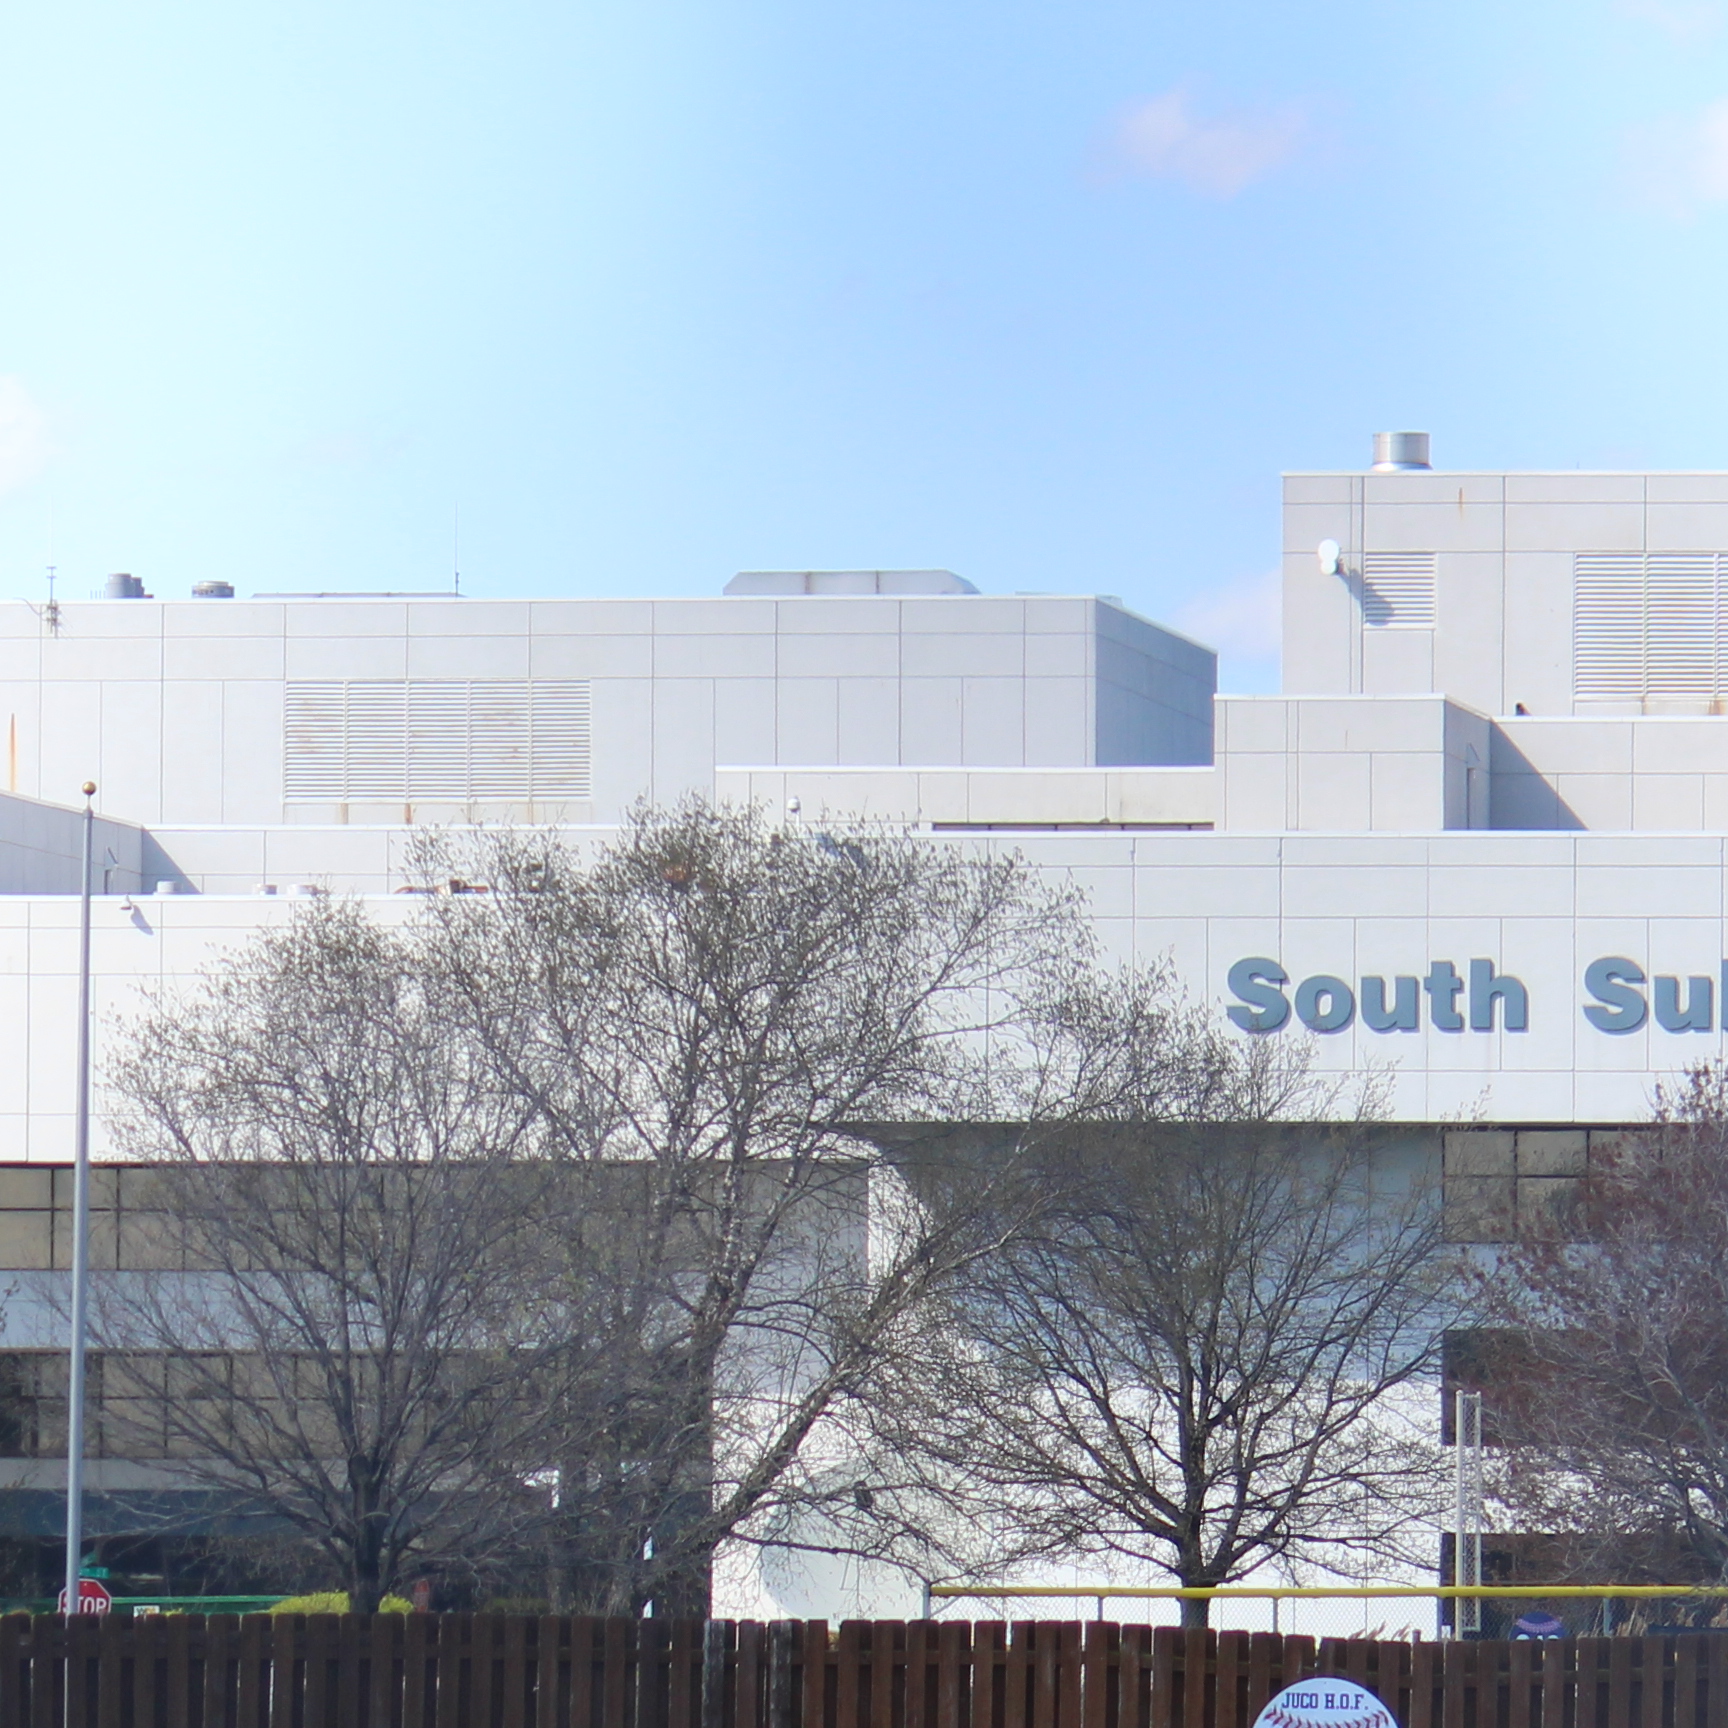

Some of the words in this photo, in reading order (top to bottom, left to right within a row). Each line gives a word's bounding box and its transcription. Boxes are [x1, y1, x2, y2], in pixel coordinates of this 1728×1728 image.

[1226, 956, 1529, 1034] South
[1282, 1693, 1319, 1709] JUCO
[1325, 1694, 1368, 1710] H.O.F.
